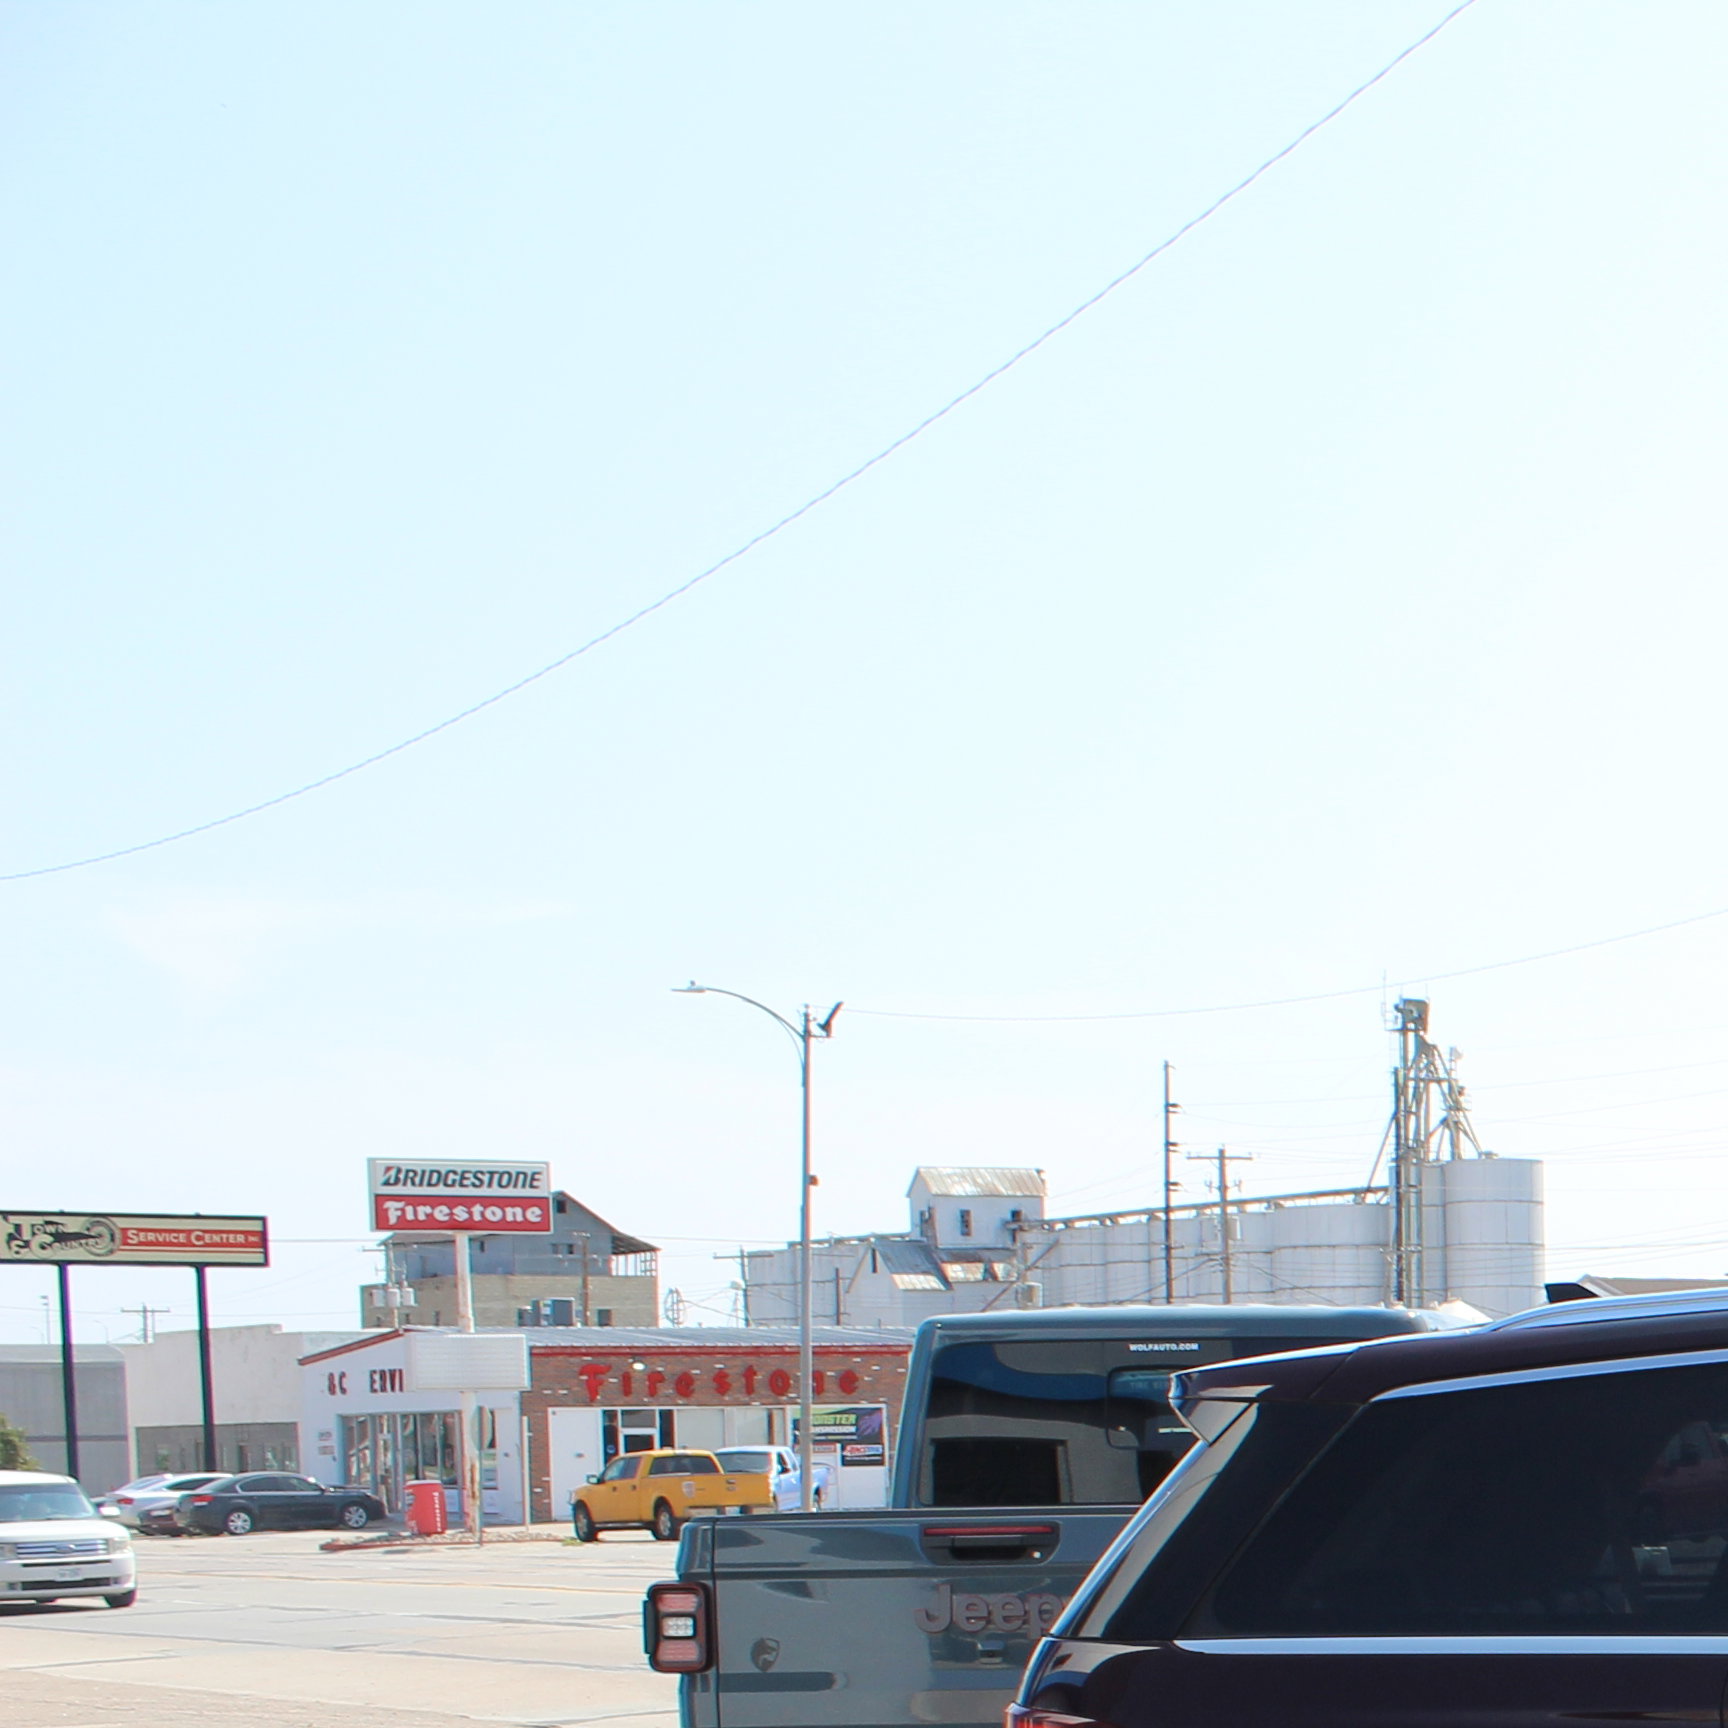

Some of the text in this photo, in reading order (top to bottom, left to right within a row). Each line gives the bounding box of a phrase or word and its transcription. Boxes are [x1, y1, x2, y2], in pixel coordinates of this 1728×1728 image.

[381, 1165, 544, 1189] BRIDGESTONE
[383, 1200, 544, 1226] Firestone
[1128, 1343, 1199, 1352] WOLFAUTO.COM
[579, 1364, 859, 1402] Firestone
[811, 1414, 857, 1425] ONSTER
[914, 1584, 1064, 1640] Jeep
